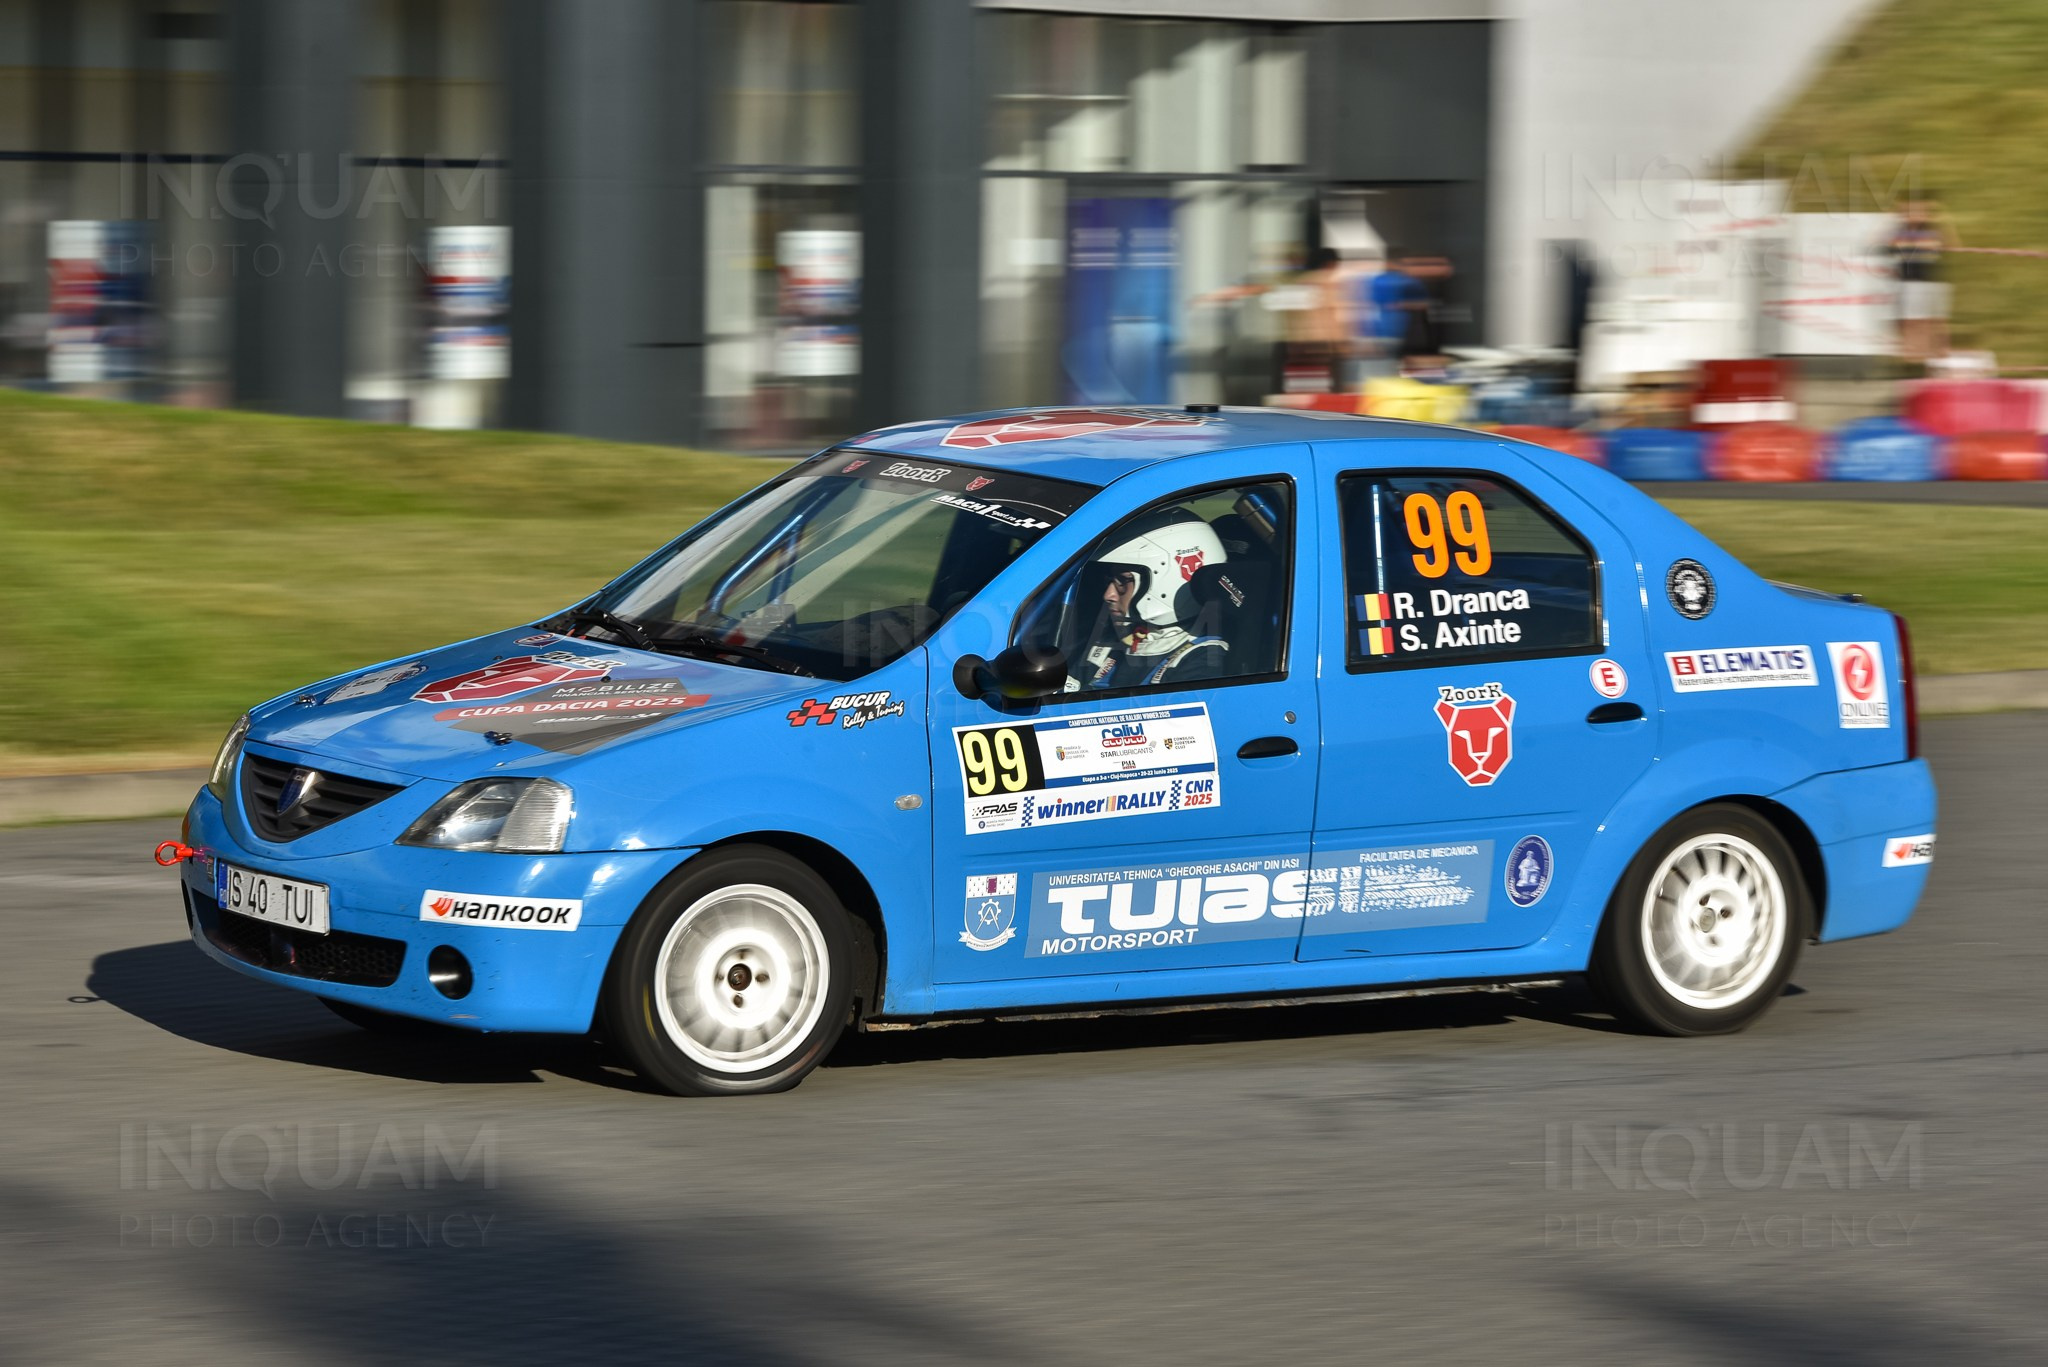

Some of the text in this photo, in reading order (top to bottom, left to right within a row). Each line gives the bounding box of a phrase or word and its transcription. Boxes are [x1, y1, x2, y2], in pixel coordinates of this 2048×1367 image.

[1403, 490, 1492, 579] 99
[1392, 588, 1530, 619] R. Dranca
[1400, 619, 1522, 651] S. Axinte
[1698, 650, 1805, 673] ELEMATIS
[556, 682, 677, 694] MOBILIZE
[1601, 667, 1617, 687] E
[458, 697, 688, 717] CUPA DACIA 2025
[828, 691, 891, 710] BUCUR
[843, 712, 866, 728] Rally
[961, 727, 1028, 796] 99
[1185, 779, 1214, 794] CNR
[1037, 790, 1166, 820] winner RALLY
[1184, 793, 1213, 807] 2025
[1359, 845, 1479, 863] FACULTATEA DE MECANICA
[1049, 871, 1121, 886] UNIVERSITATEA
[1122, 868, 1163, 882] TEHNICA
[1264, 859, 1280, 870] DIN
[1281, 857, 1300, 869] IASI
[228, 869, 242, 908] IS
[248, 875, 268, 914] 40
[282, 884, 313, 926] TUI
[1041, 928, 1199, 955] MOTORSPORT
